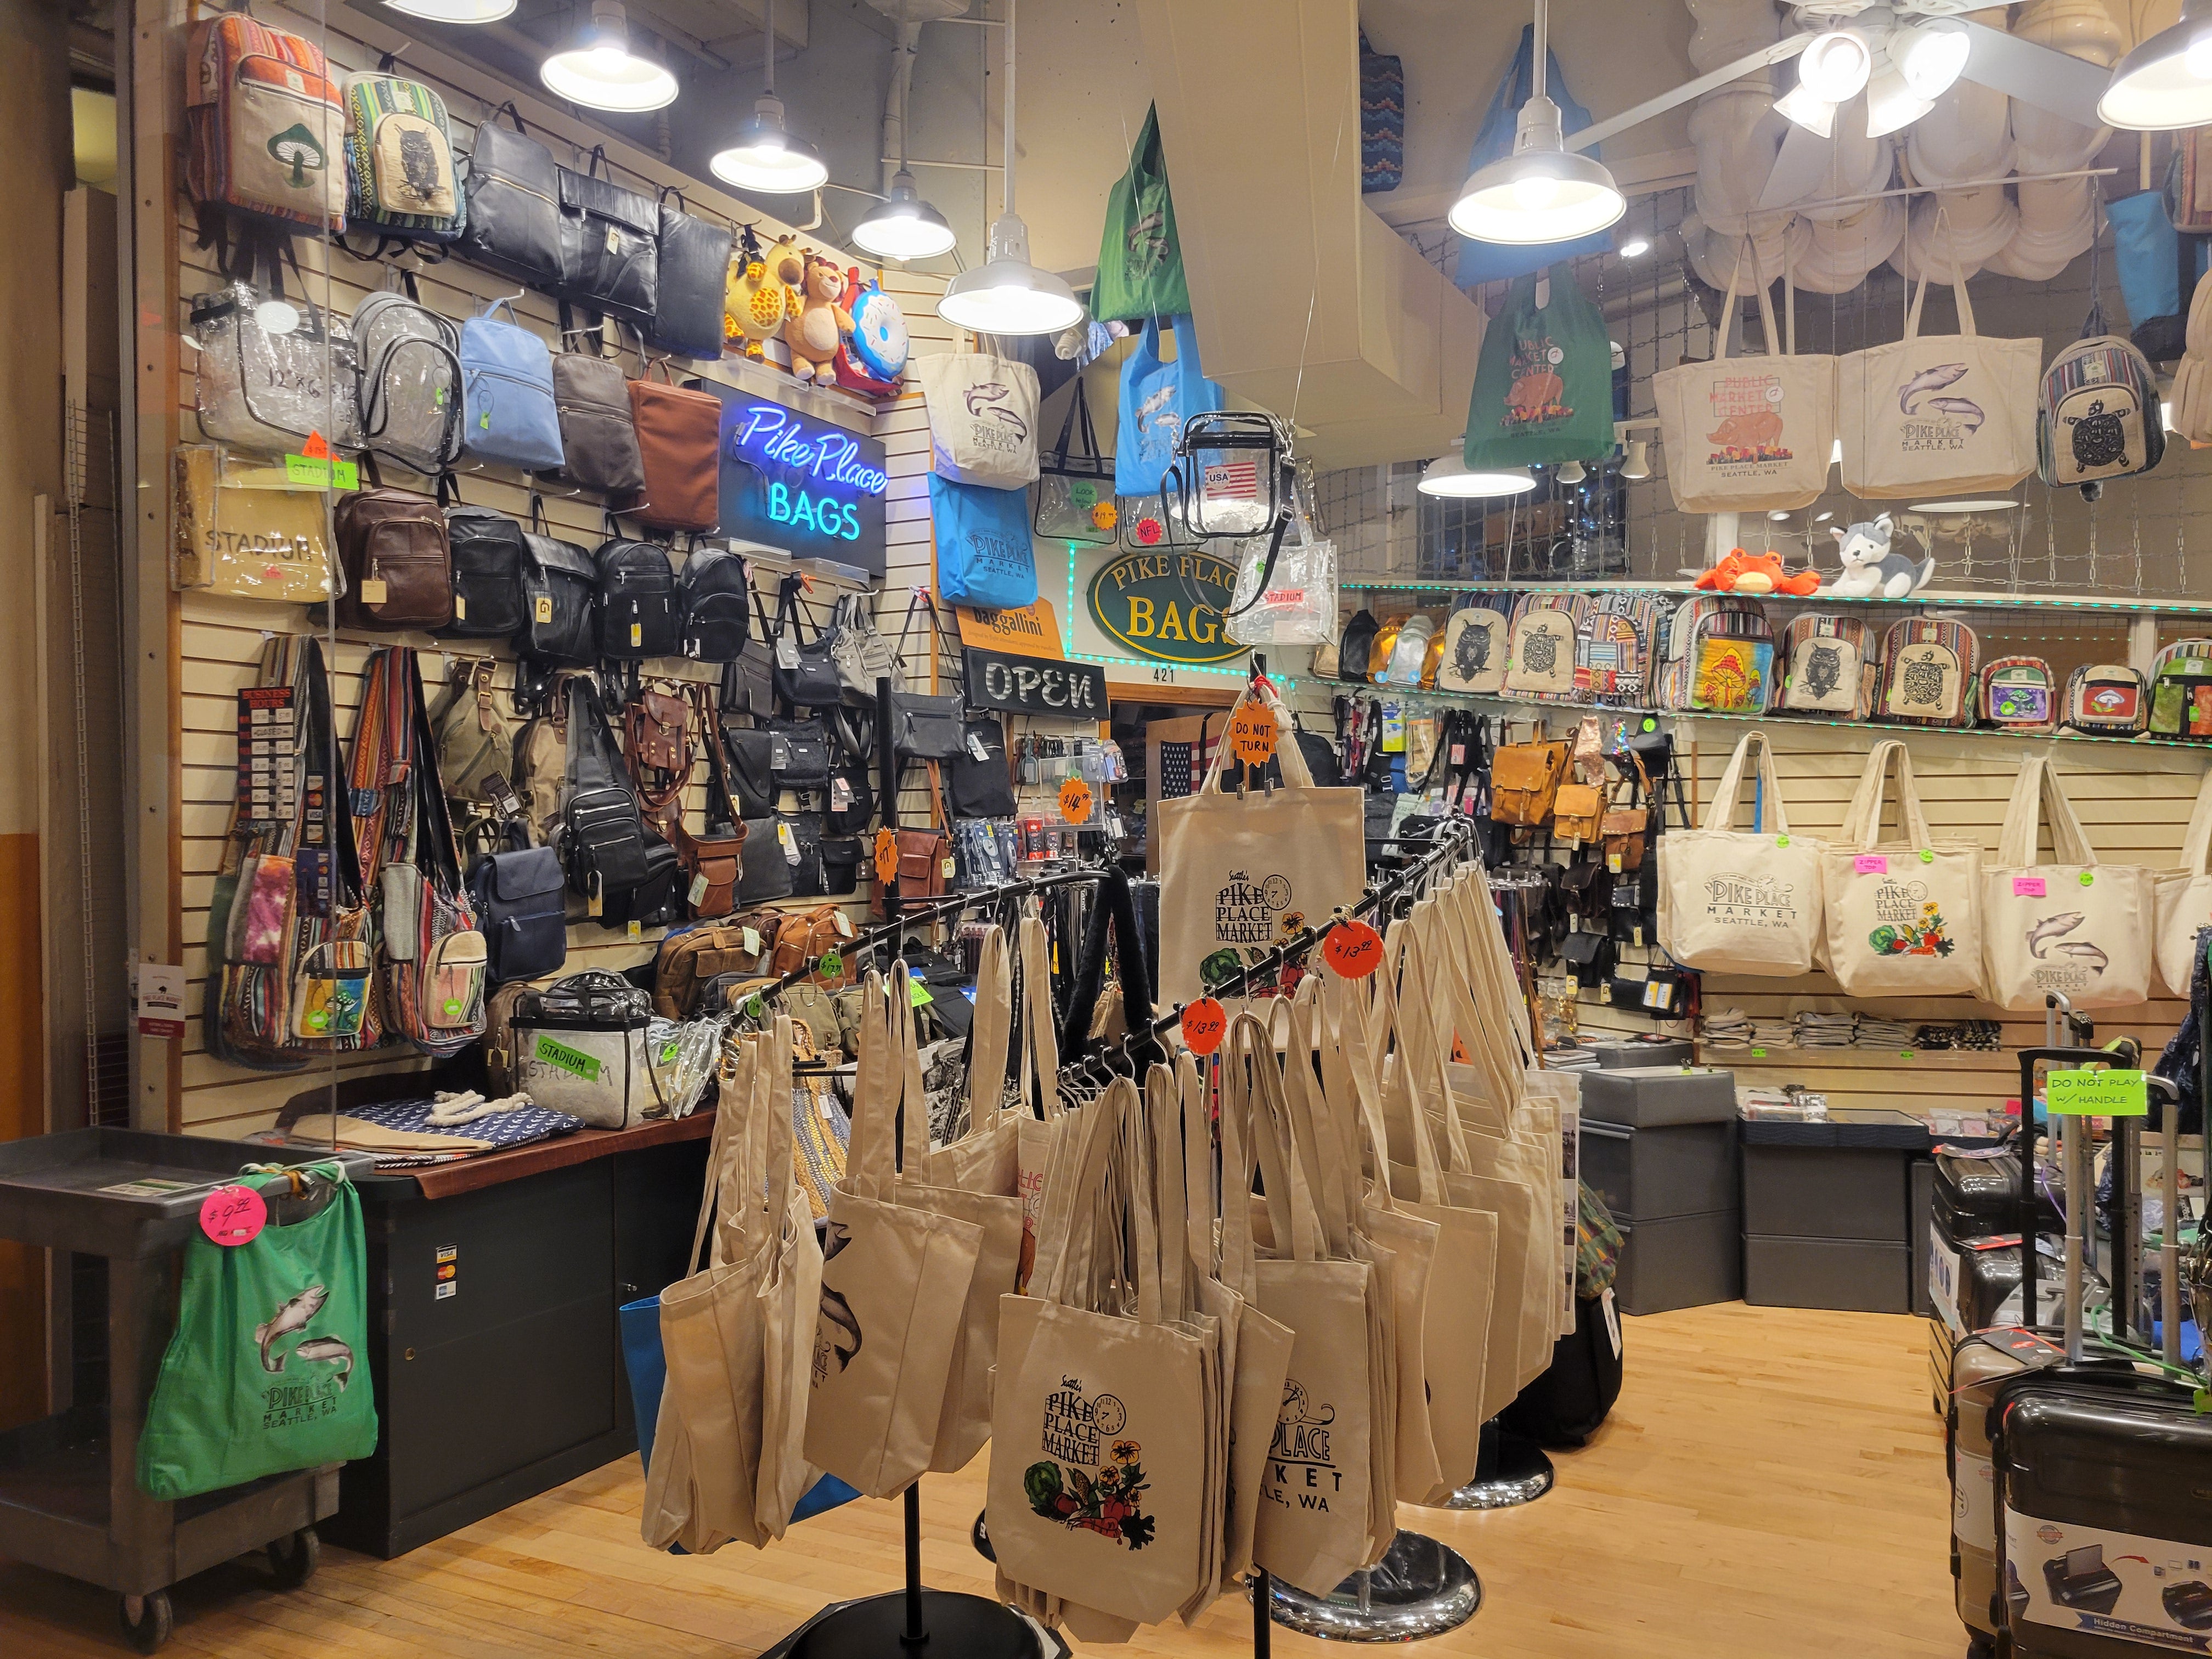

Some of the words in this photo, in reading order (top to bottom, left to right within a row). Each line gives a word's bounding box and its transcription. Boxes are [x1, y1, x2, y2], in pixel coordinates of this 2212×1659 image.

[1725, 375, 1773, 388] PUBLIC
[1709, 390, 1764, 403] MARKET
[1718, 404, 1773, 417] CENTER
[973, 423, 995, 439] PIKE
[1905, 424, 1933, 439] PIKE
[741, 407, 815, 467] Pike
[807, 433, 889, 494] Place
[973, 437, 1017, 450] MARKET
[1209, 474, 1228, 482] USA
[769, 482, 860, 540] BAGS
[1140, 524, 1160, 538] NFL
[205, 530, 312, 561] STADIUM
[972, 534, 1006, 558] PIKE
[976, 558, 1029, 573] MARKET
[983, 566, 1014, 577] SEATTLE,
[1110, 556, 1171, 591] PIKE
[1180, 555, 1238, 593] PLAC
[1265, 592, 1302, 602] STADIUM
[973, 607, 1043, 637] baggallini
[1154, 668, 1174, 683] 421
[985, 662, 1096, 709] OPEN
[242, 689, 291, 699] BUSINESS
[250, 698, 285, 708] HOURS
[1236, 722, 1249, 734] DO
[1252, 724, 1271, 738] NOT
[1239, 740, 1269, 752] TURN
[1218, 882, 1264, 906] PIKE
[1713, 881, 1752, 905] PIKE
[1755, 889, 1791, 907] PLACE
[1876, 885, 1909, 900] PIKE
[1875, 899, 1916, 909] PLACE
[1216, 906, 1271, 922] PLACE
[1707, 906, 1797, 919] MARKET
[1876, 909, 1917, 922] MARKET
[1714, 917, 1768, 928] SEATTLE,
[1771, 921, 1789, 929] WA
[1216, 922, 1272, 943] MARKET
[2035, 969, 2062, 983] PIKE
[539, 1042, 586, 1072] STADIUM
[2052, 1079, 2072, 1088] DO
[2077, 1078, 2103, 1087] NOT
[2109, 1079, 2140, 1087] PLAY
[2079, 1096, 2128, 1104] HANDLE
[268, 1387, 304, 1409] PIKE
[263, 1397, 337, 1423] MARKET
[1048, 1391, 1094, 1422] PIKE
[263, 1412, 317, 1430] SEATTLE,
[322, 1406, 337, 1417] WA
[1043, 1412, 1098, 1444] PLACE
[1043, 1430, 1099, 1465] MARKET
[1297, 1494, 1329, 1513] WA
[2093, 1617, 2126, 1630] Hidden
[2129, 1624, 2194, 1644] Compartment
